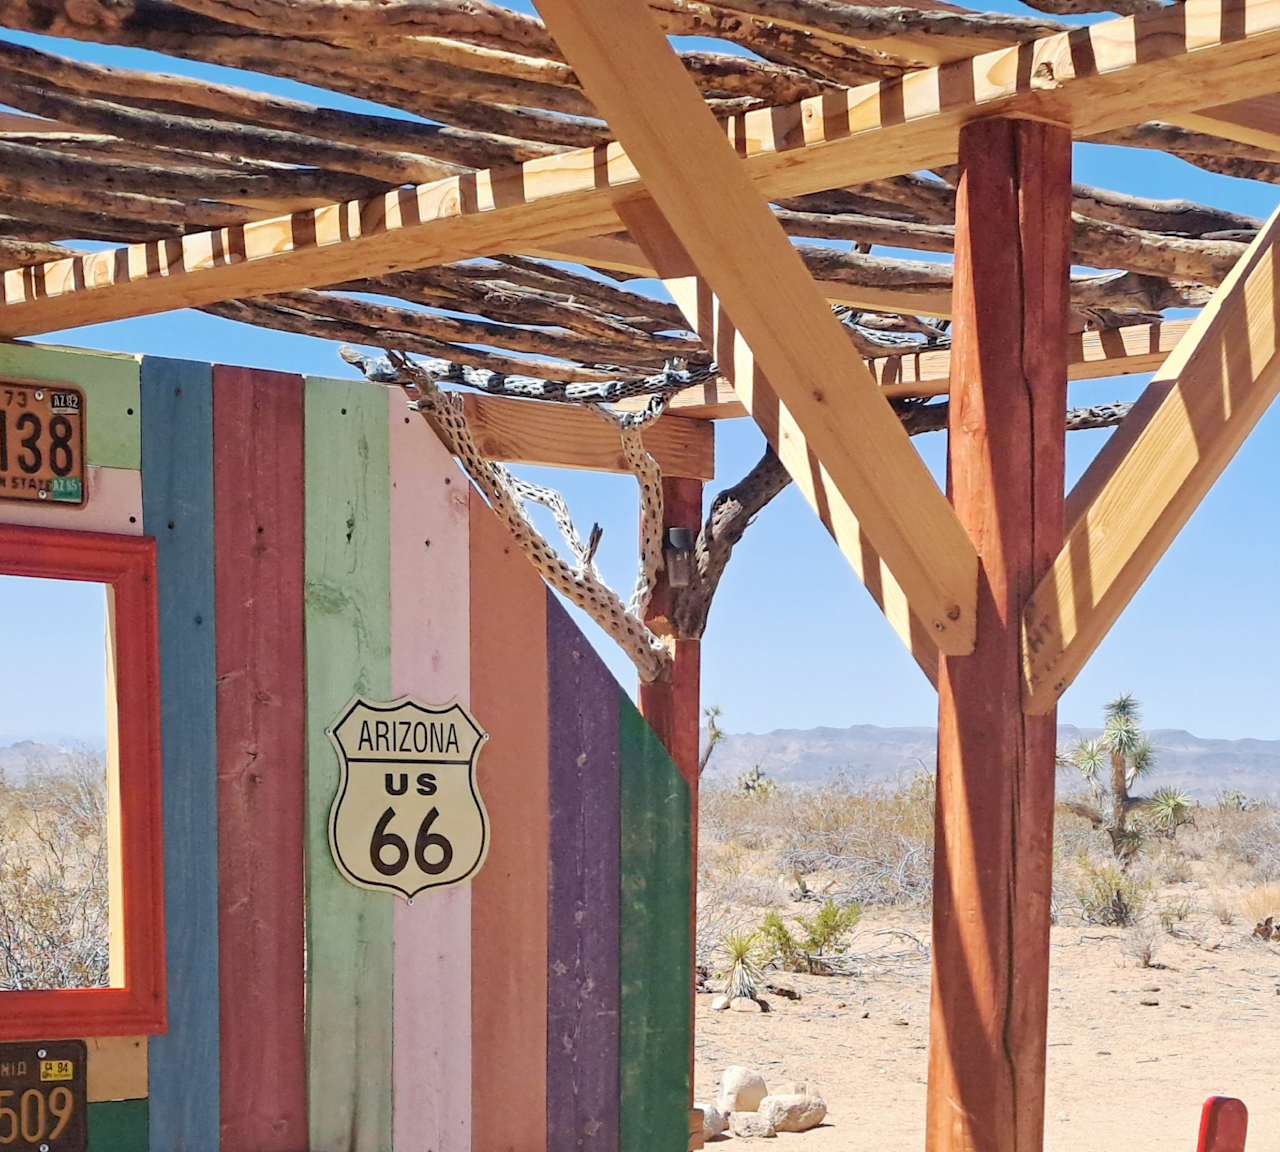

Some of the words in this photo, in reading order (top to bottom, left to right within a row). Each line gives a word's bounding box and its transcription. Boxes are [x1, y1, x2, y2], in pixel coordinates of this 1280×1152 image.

[4, 390, 28, 408] 73
[11, 477, 52, 493] STATE
[358, 719, 460, 754] ARIZONA
[384, 773, 438, 796] US
[369, 806, 453, 876] 66
